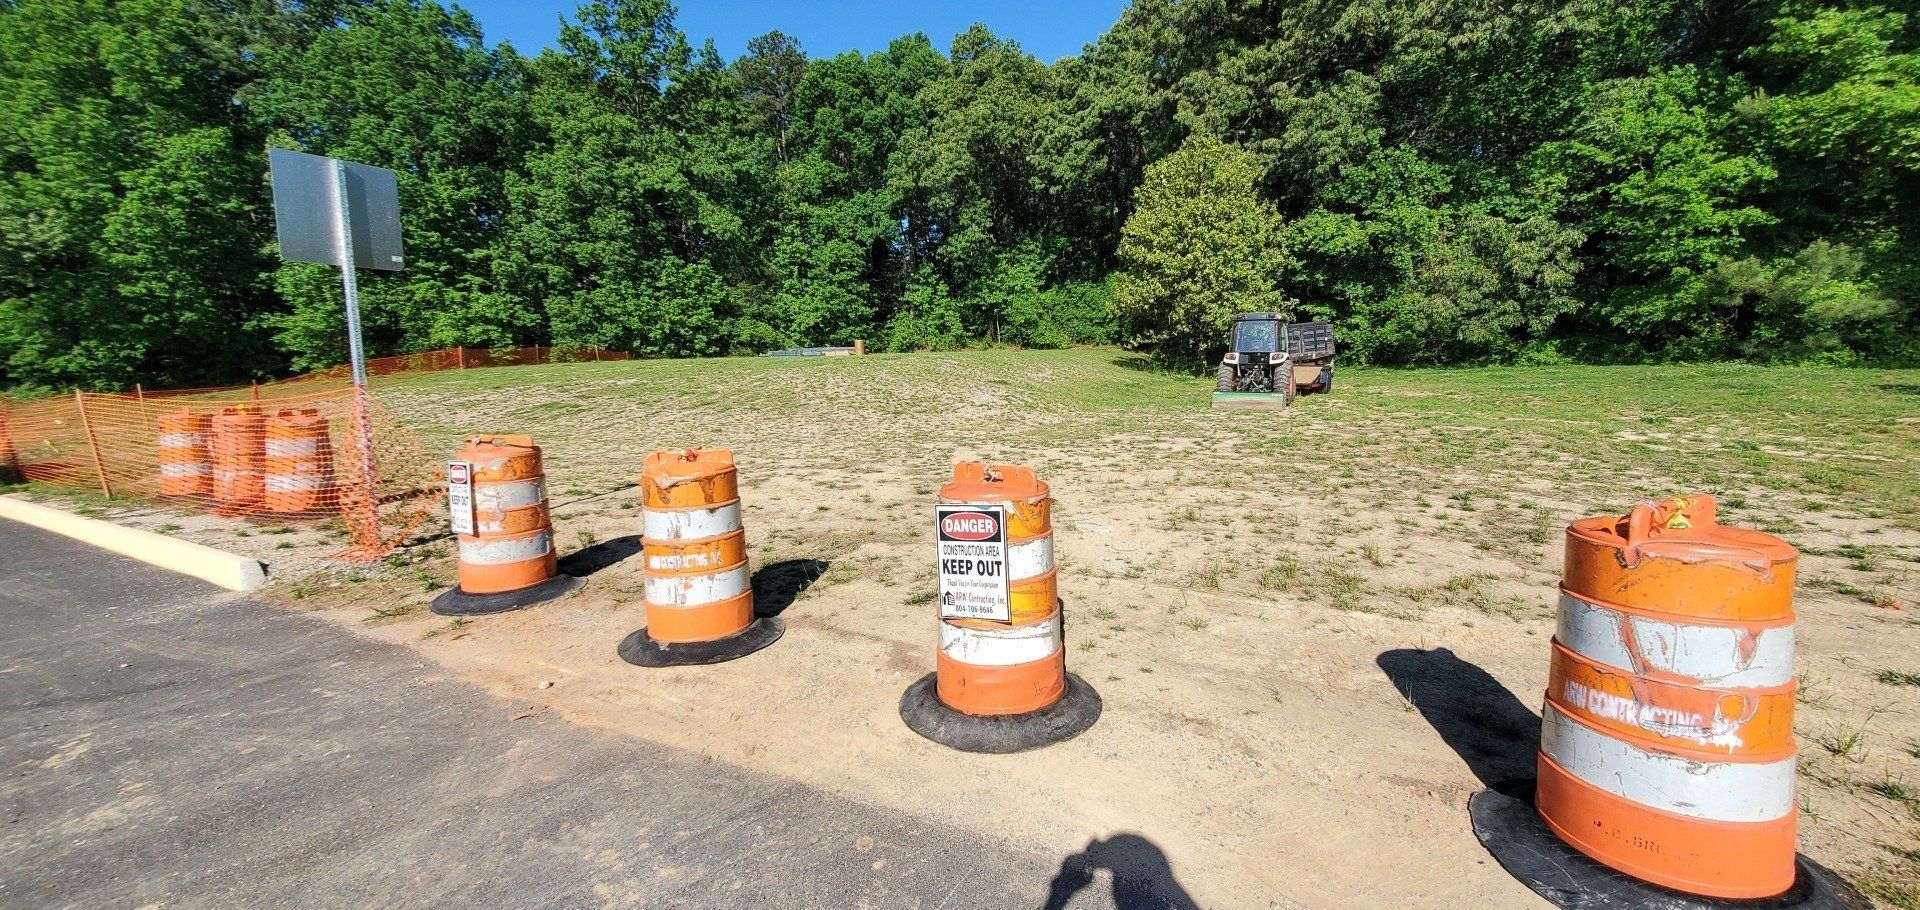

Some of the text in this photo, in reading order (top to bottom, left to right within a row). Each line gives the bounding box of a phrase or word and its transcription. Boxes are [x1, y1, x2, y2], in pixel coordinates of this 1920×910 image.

[945, 518, 994, 533] DANGER
[943, 544, 1000, 557] CONSTRUCTION AREA
[943, 559, 1003, 577] KEEP OUT
[955, 592, 967, 601] ARW
[997, 595, 1007, 605] Inc.
[1563, 679, 1587, 708] ARW
